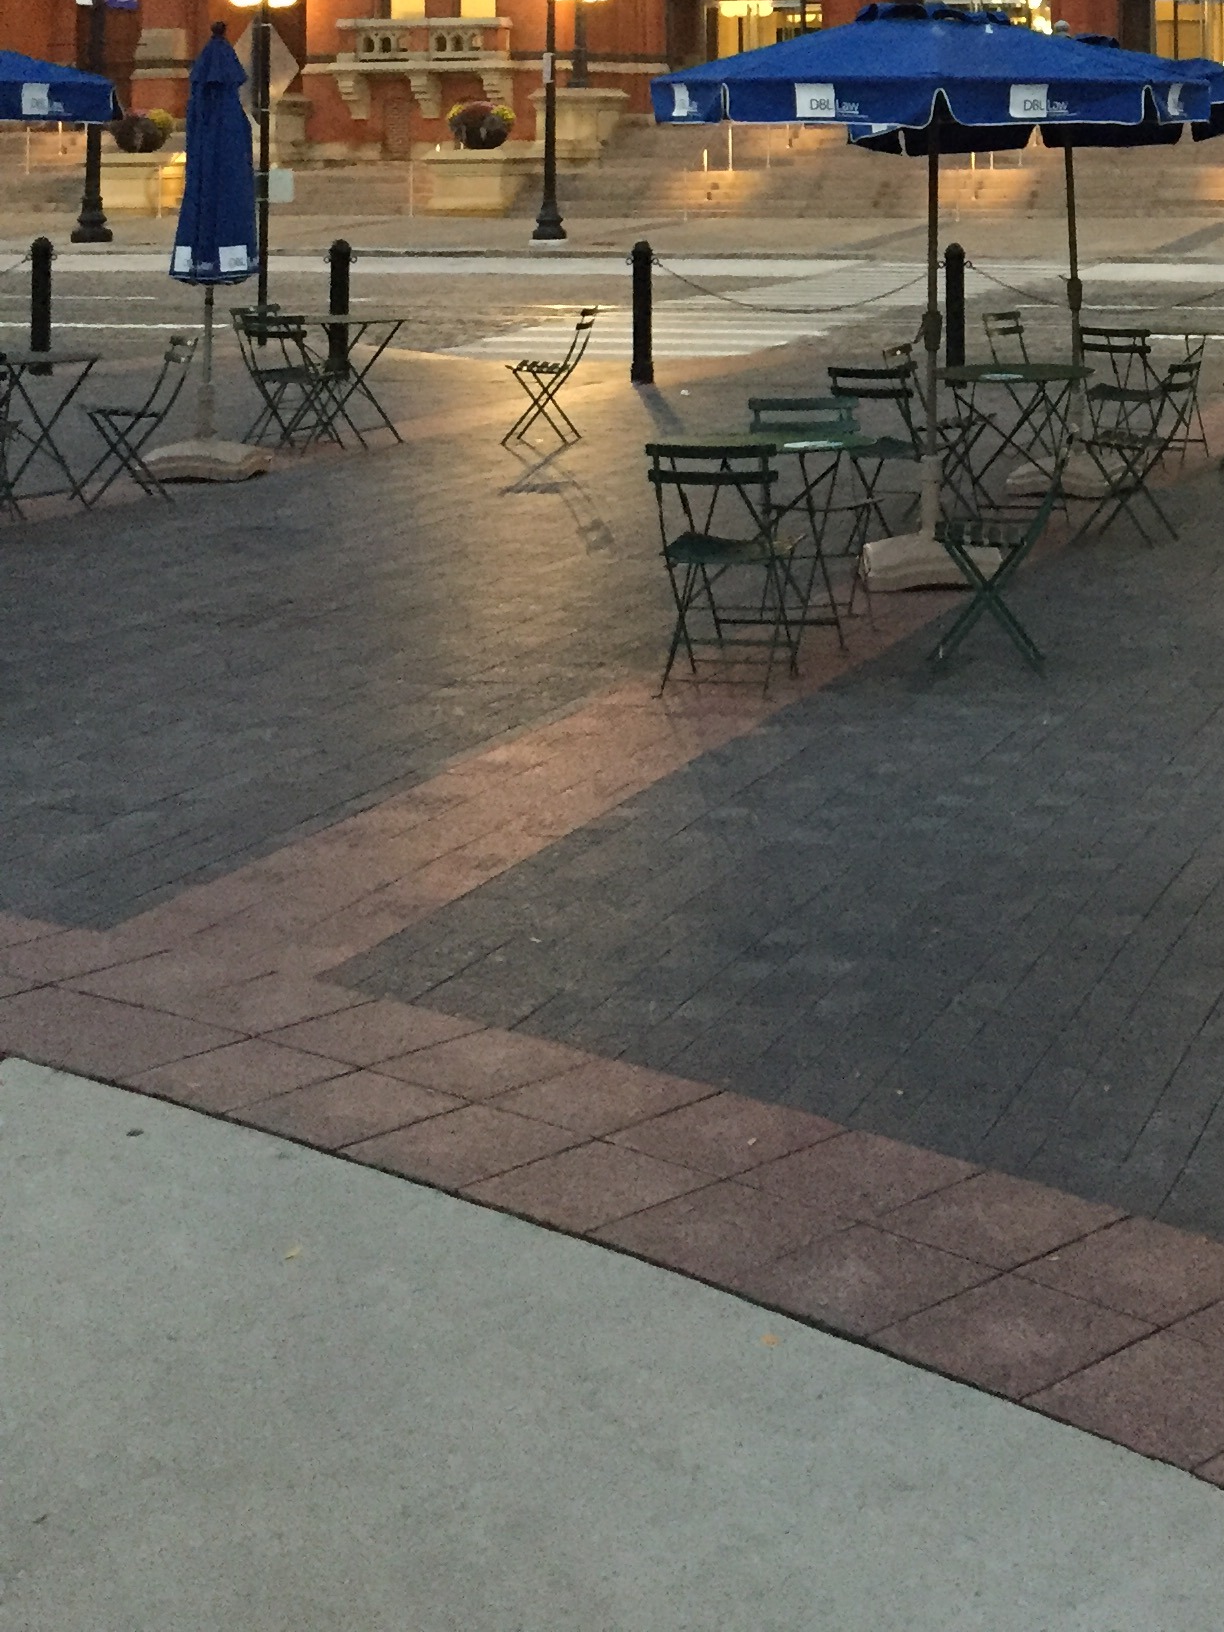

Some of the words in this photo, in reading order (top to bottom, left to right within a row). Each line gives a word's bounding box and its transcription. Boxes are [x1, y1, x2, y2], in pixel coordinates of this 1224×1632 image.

[809, 98, 835, 111] DBL
[835, 99, 860, 111] Law
[1023, 98, 1044, 112] DBL
[1046, 99, 1069, 111] Law
